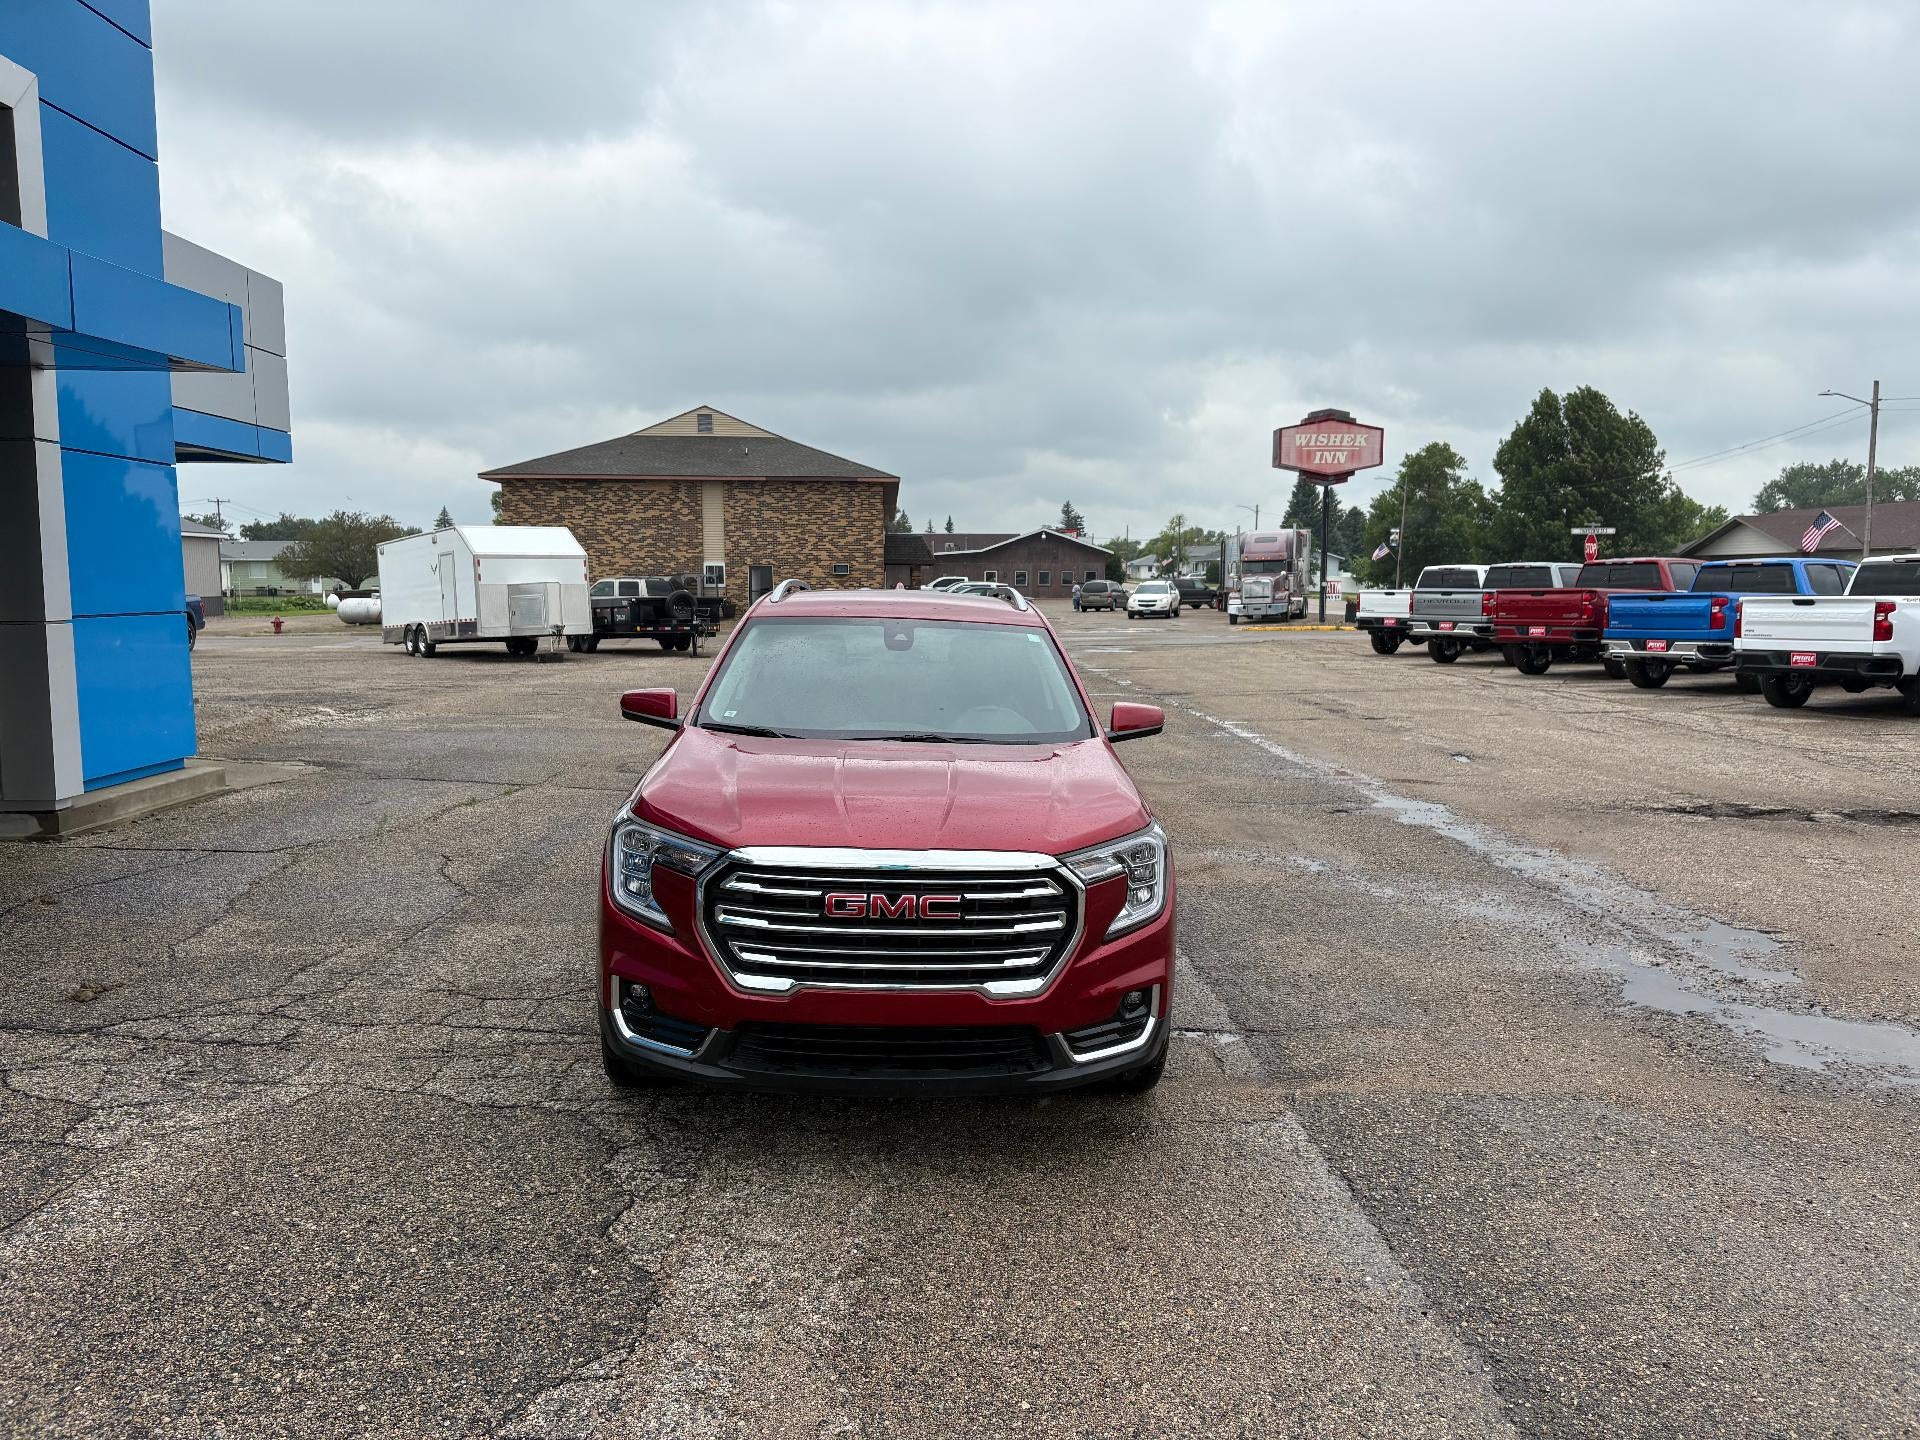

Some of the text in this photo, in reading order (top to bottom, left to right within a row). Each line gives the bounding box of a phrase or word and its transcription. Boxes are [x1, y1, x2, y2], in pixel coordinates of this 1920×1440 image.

[1295, 434, 1368, 447] WISHEK
[1314, 451, 1348, 464] INN
[1585, 543, 1597, 554] STOP
[824, 893, 961, 919] GMC
